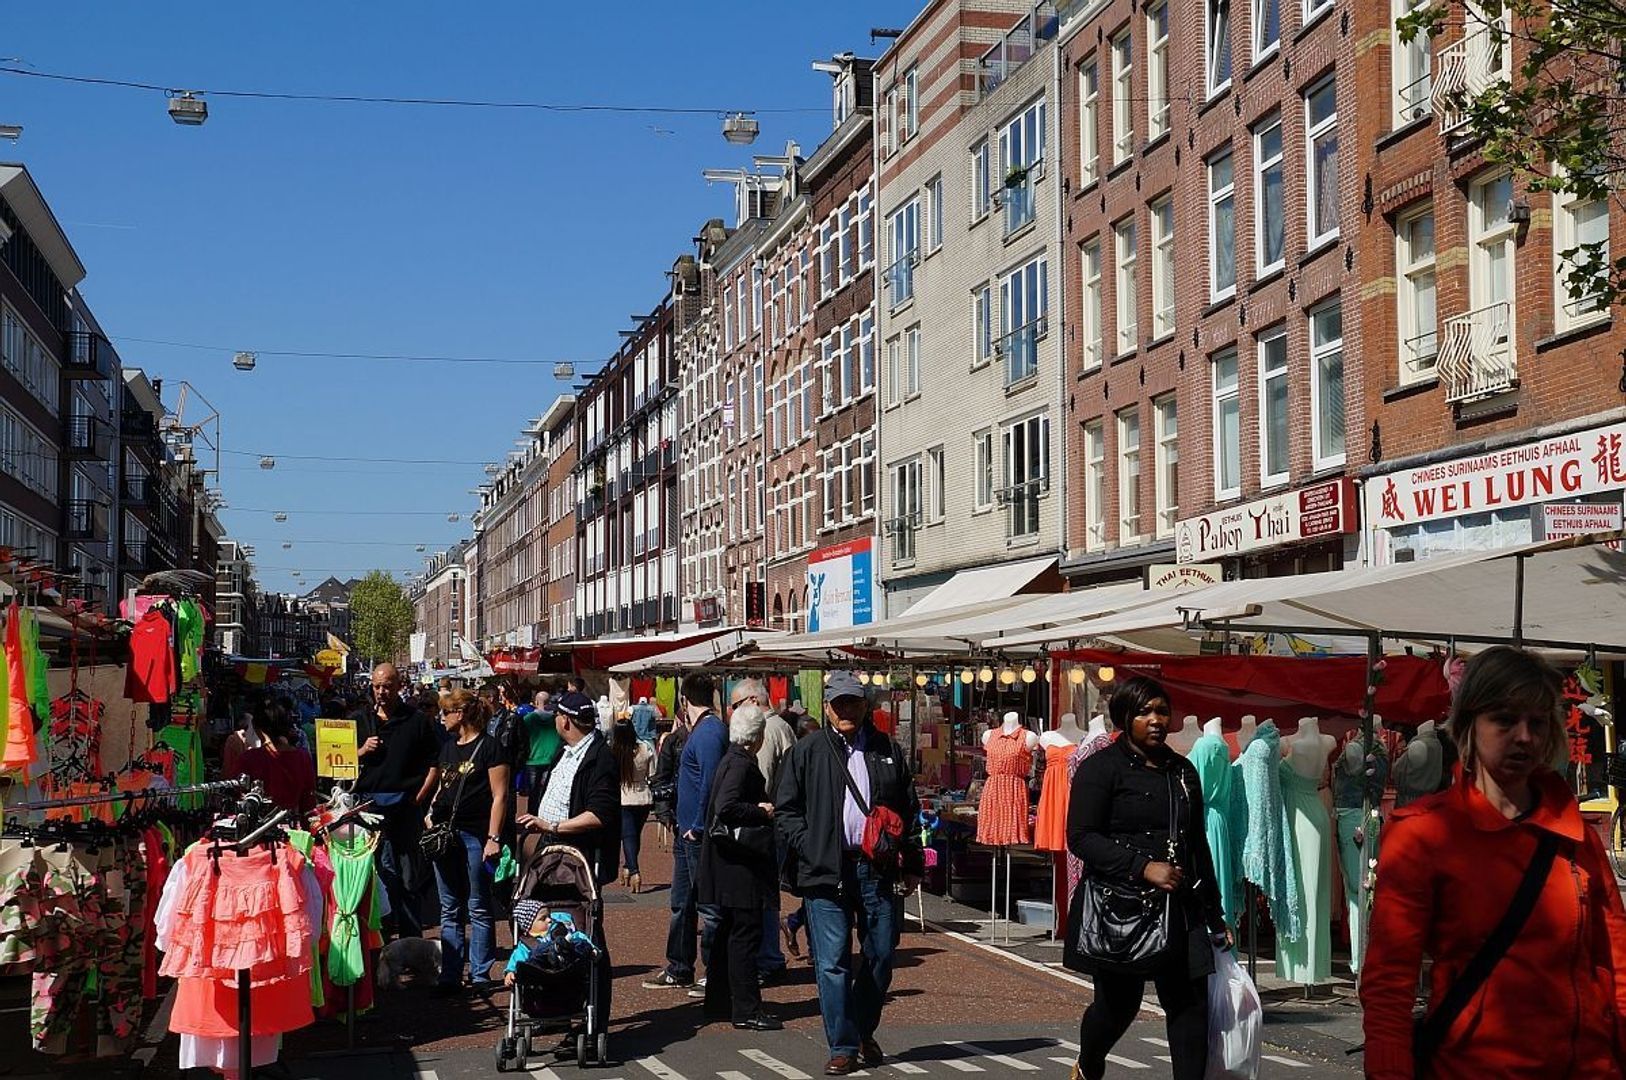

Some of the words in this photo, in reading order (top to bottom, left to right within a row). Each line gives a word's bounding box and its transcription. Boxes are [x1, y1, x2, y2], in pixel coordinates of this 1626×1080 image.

[1411, 465, 1446, 485] CHINEES
[1448, 455, 1498, 478] SURINAAMS
[1501, 447, 1540, 468] EETHUIS
[1542, 437, 1582, 459] AFHAAL
[1591, 433, 1626, 485] 龍
[1381, 476, 1405, 521] 威
[1412, 481, 1473, 519] WEI
[1484, 459, 1583, 506] LUNG
[1248, 504, 1290, 542] Thai
[1545, 506, 1576, 515] CHINEES
[1577, 506, 1618, 515] SURINAAMS
[1553, 519, 1583, 529] EETHUIS
[1584, 519, 1612, 529] AFHAAL
[1155, 569, 1176, 587] THAI
